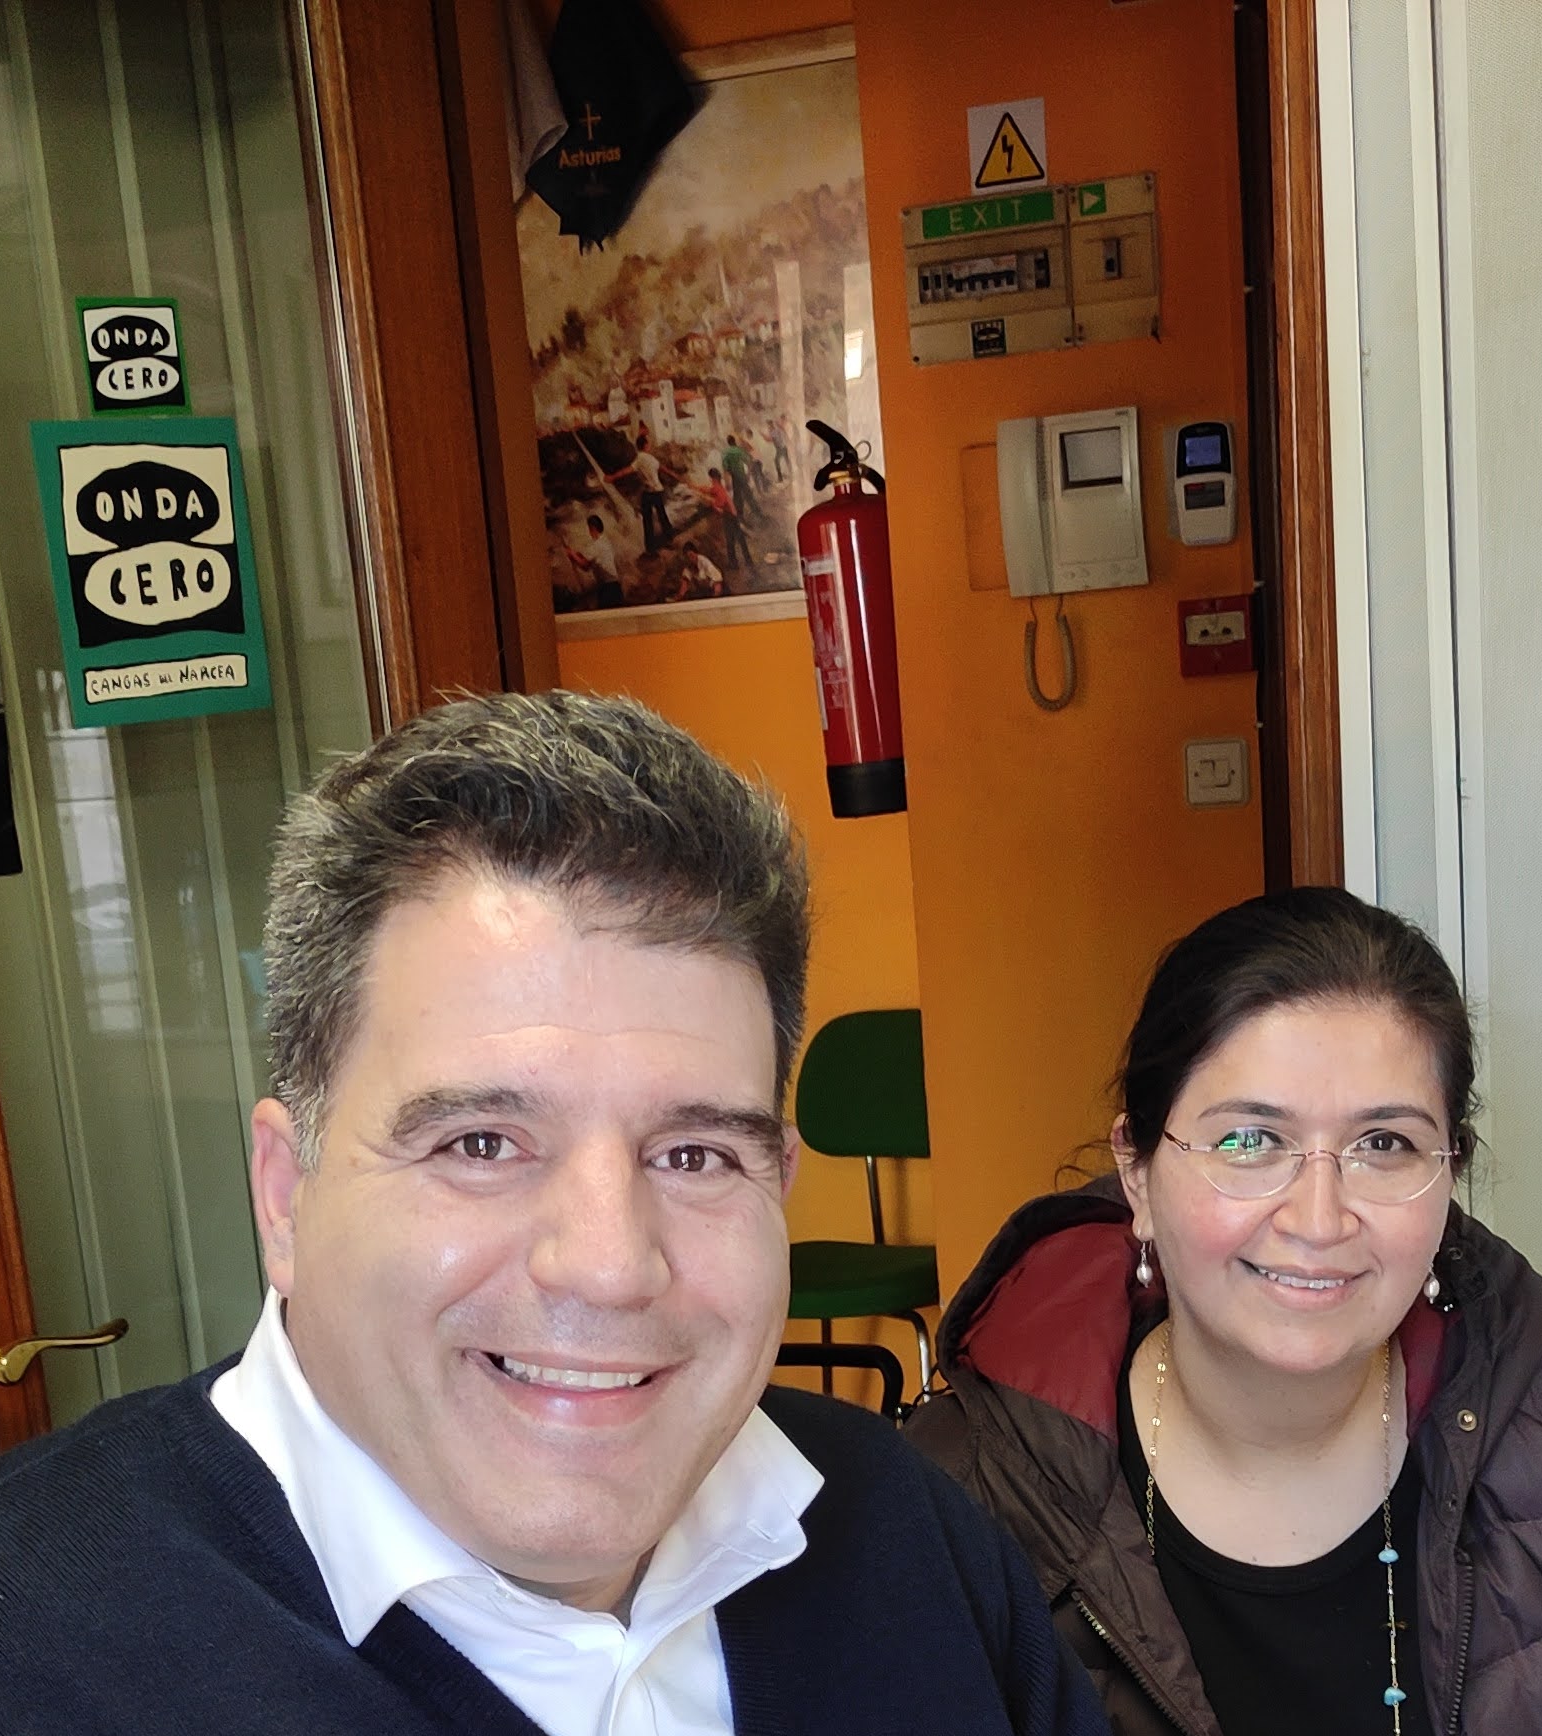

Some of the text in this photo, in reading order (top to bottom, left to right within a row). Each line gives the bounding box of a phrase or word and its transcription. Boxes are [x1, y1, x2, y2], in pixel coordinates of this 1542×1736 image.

[559, 147, 621, 169] Asturias
[949, 200, 1023, 232] EXIT
[97, 327, 164, 350] ONDA
[109, 368, 168, 391] CERO
[95, 487, 205, 522] ONDA
[110, 558, 215, 605] CERO
[91, 672, 151, 695] CANGAS
[179, 664, 235, 684] NARCEA
